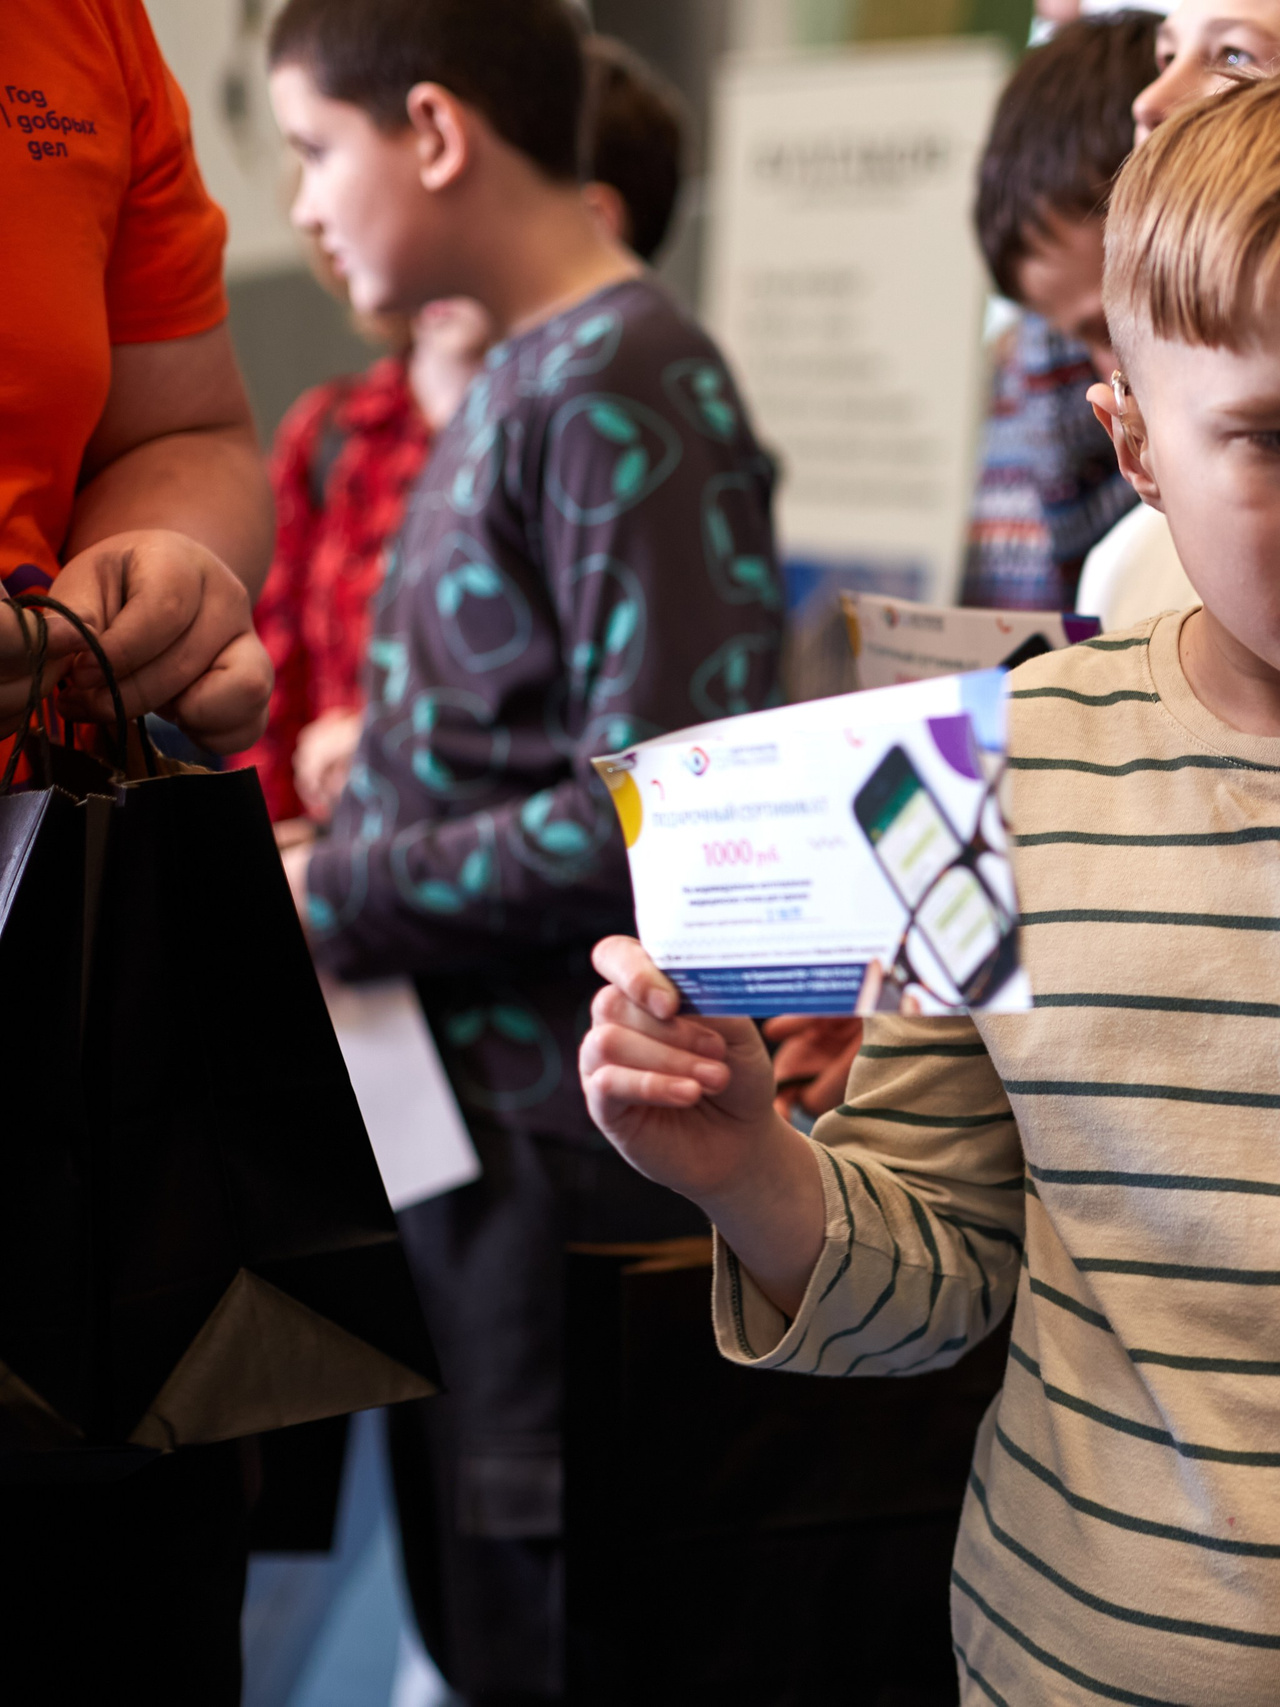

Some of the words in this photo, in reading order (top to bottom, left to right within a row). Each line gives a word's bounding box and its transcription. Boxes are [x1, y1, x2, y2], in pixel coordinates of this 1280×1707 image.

[5, 85, 47, 108] Год
[17, 110, 97, 135] добрых
[28, 140, 68, 160] дел
[701, 837, 753, 868] 1000
